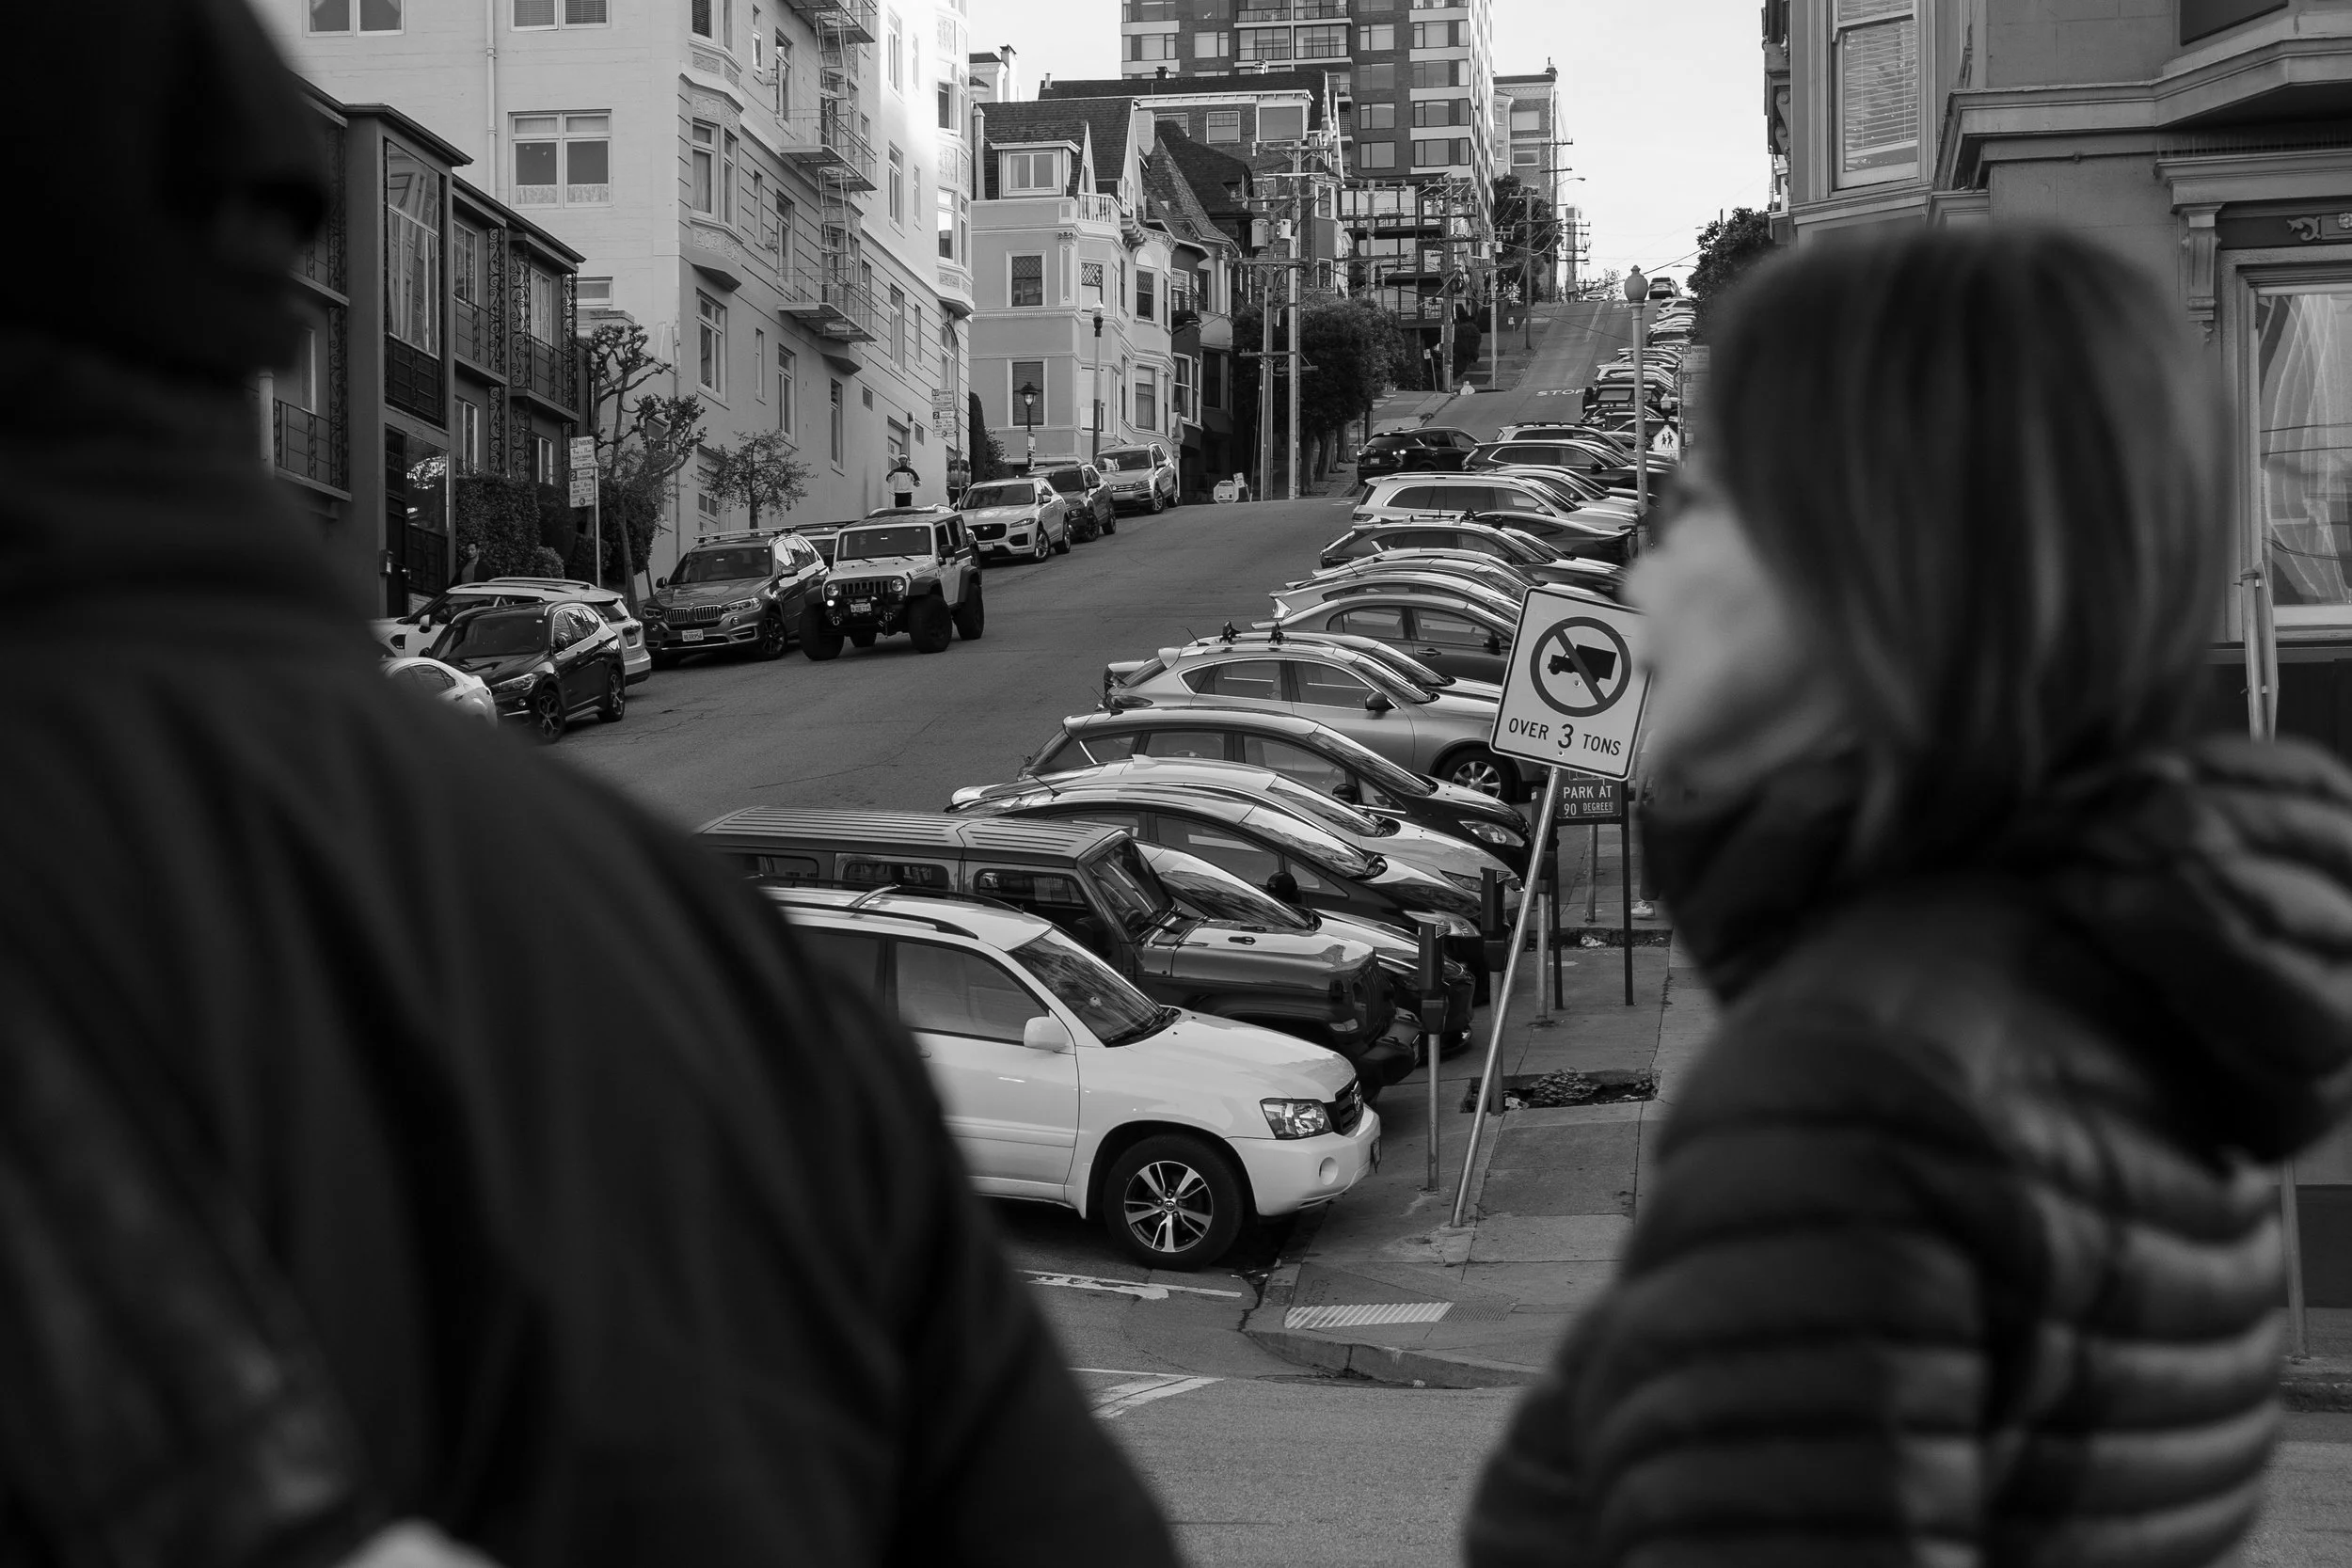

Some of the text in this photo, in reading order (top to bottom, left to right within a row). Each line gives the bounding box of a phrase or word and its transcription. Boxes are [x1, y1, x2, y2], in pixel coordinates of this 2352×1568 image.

[1535, 388, 1586, 397] STOP
[570, 471, 577, 481] 2
[1509, 718, 1621, 756] OVER 3 TONS
[1563, 784, 1613, 799] PARK AT
[1564, 801, 1613, 816] 90 DEGREES
